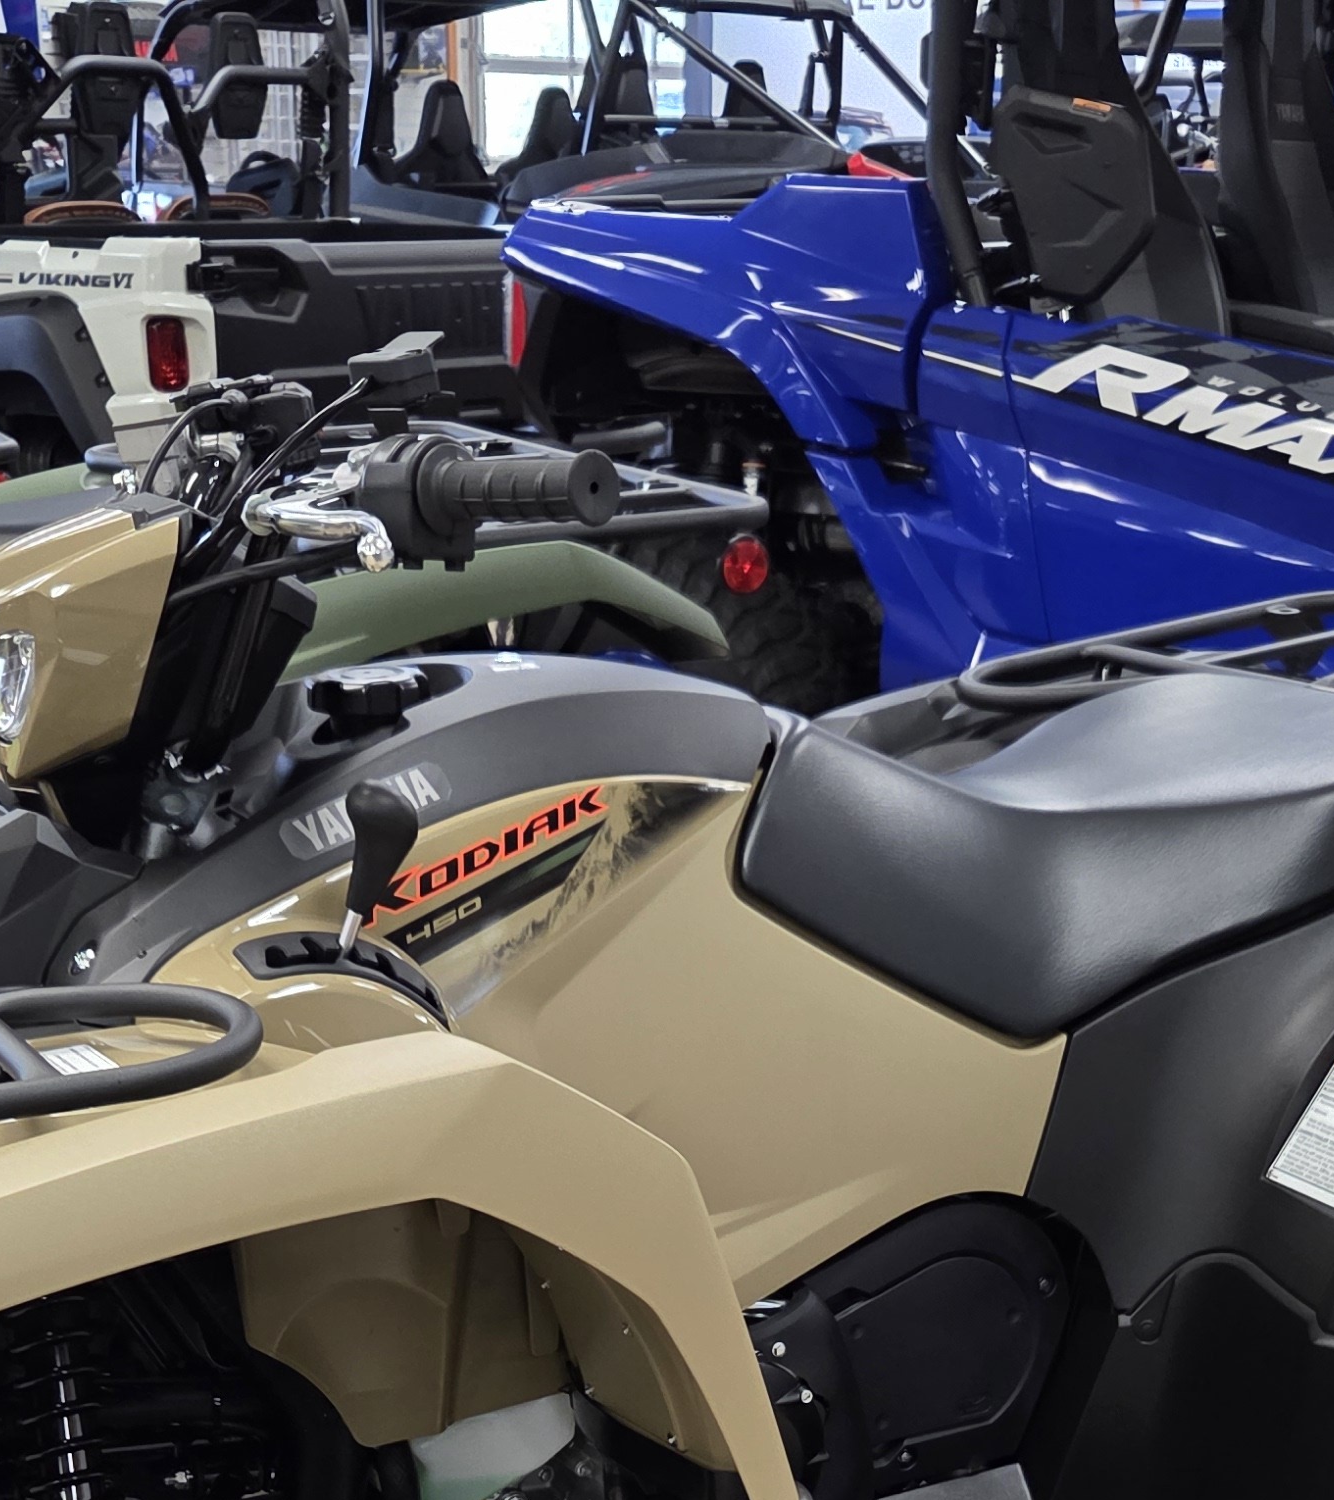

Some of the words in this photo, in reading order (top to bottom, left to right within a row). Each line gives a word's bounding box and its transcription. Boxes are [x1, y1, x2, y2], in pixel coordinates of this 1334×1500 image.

[18, 272, 111, 288] VIKING
[361, 785, 609, 928] KODIAK
[405, 896, 482, 944] 450
